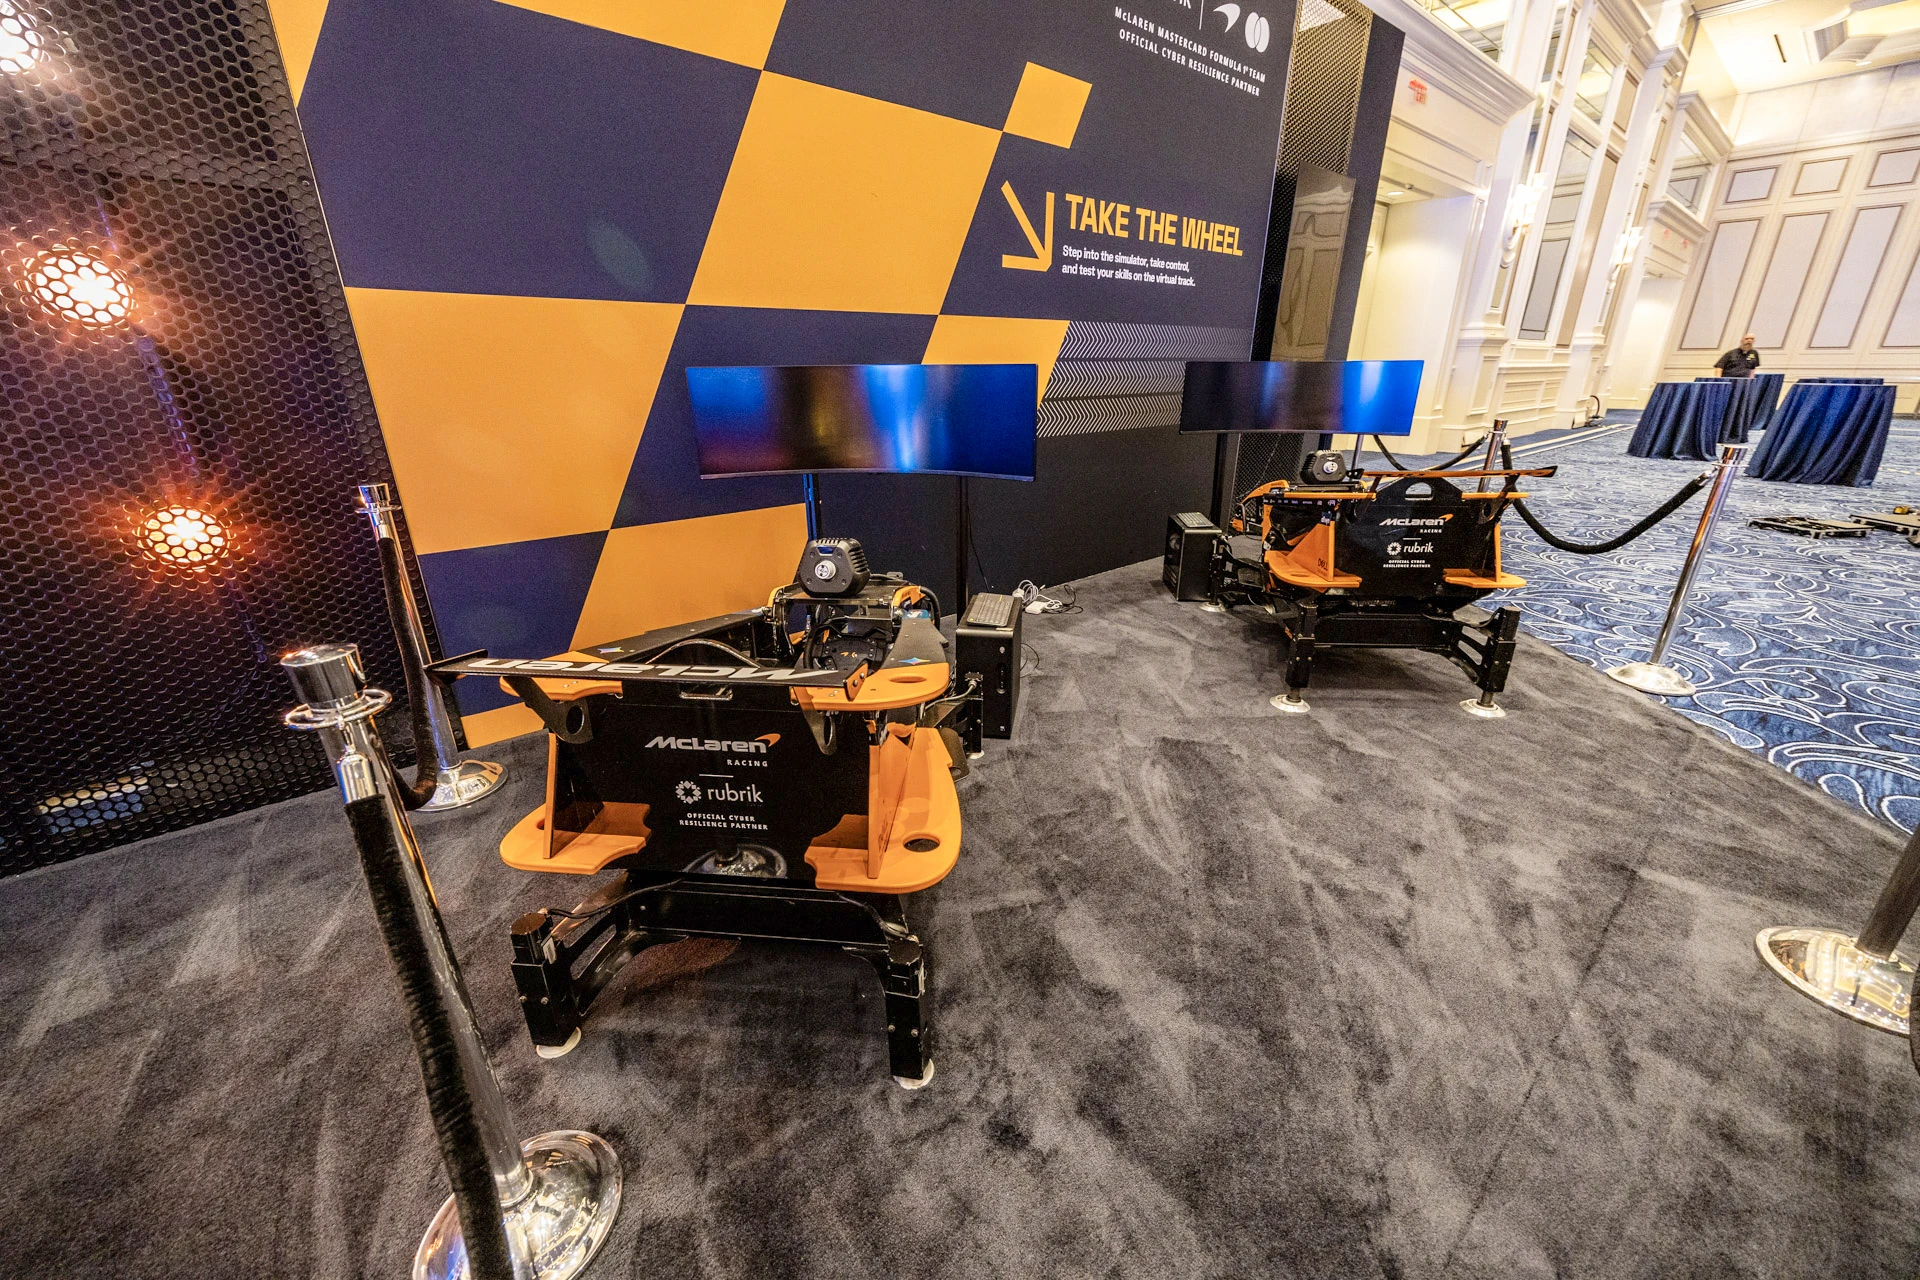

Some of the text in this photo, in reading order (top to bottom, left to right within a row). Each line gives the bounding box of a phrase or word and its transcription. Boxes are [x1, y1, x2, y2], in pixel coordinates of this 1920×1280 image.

[1115, 6, 1154, 33] McLAREN
[1158, 26, 1207, 57] MASTERCARD
[1210, 50, 1241, 72] FORMULA
[1249, 67, 1266, 83] TEAM
[1119, 28, 1260, 96] OFFICIAL CYBER RESILIENCE PARTNER
[1065, 193, 1244, 257] TAKE THE WHEEL
[1062, 245, 1190, 273] Step into the simulator, take control,
[1061, 264, 1196, 287] and test your skills on the virtual track.
[1378, 517, 1445, 526] McLaren
[1403, 541, 1434, 553] rubrik
[645, 735, 767, 754] McLaren
[726, 759, 769, 767] RACING
[707, 782, 764, 803] rubrik
[679, 819, 769, 831] RESILIENCE PARTNER
[686, 812, 756, 822] OFFICIAL CYBER
